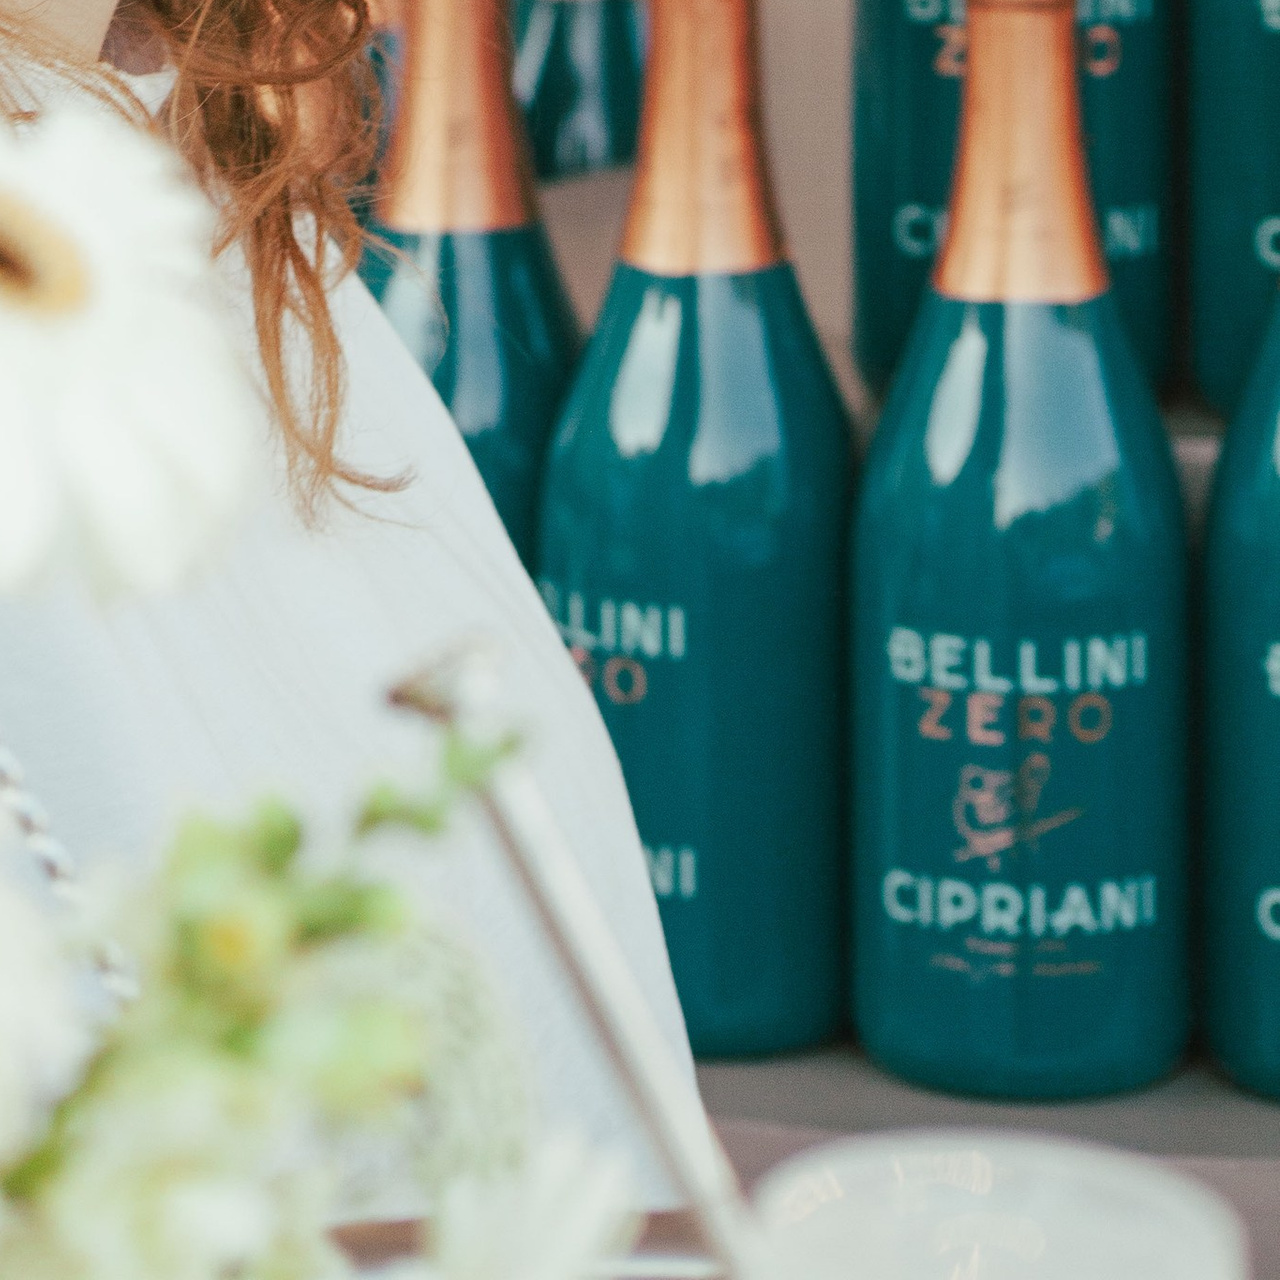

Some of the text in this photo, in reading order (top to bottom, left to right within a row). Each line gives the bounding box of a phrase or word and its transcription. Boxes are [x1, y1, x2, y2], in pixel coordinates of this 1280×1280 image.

[887, 626, 1148, 691] BELLINI
[918, 686, 1113, 746] ZERO
[882, 868, 1158, 937] CIPRIANI
